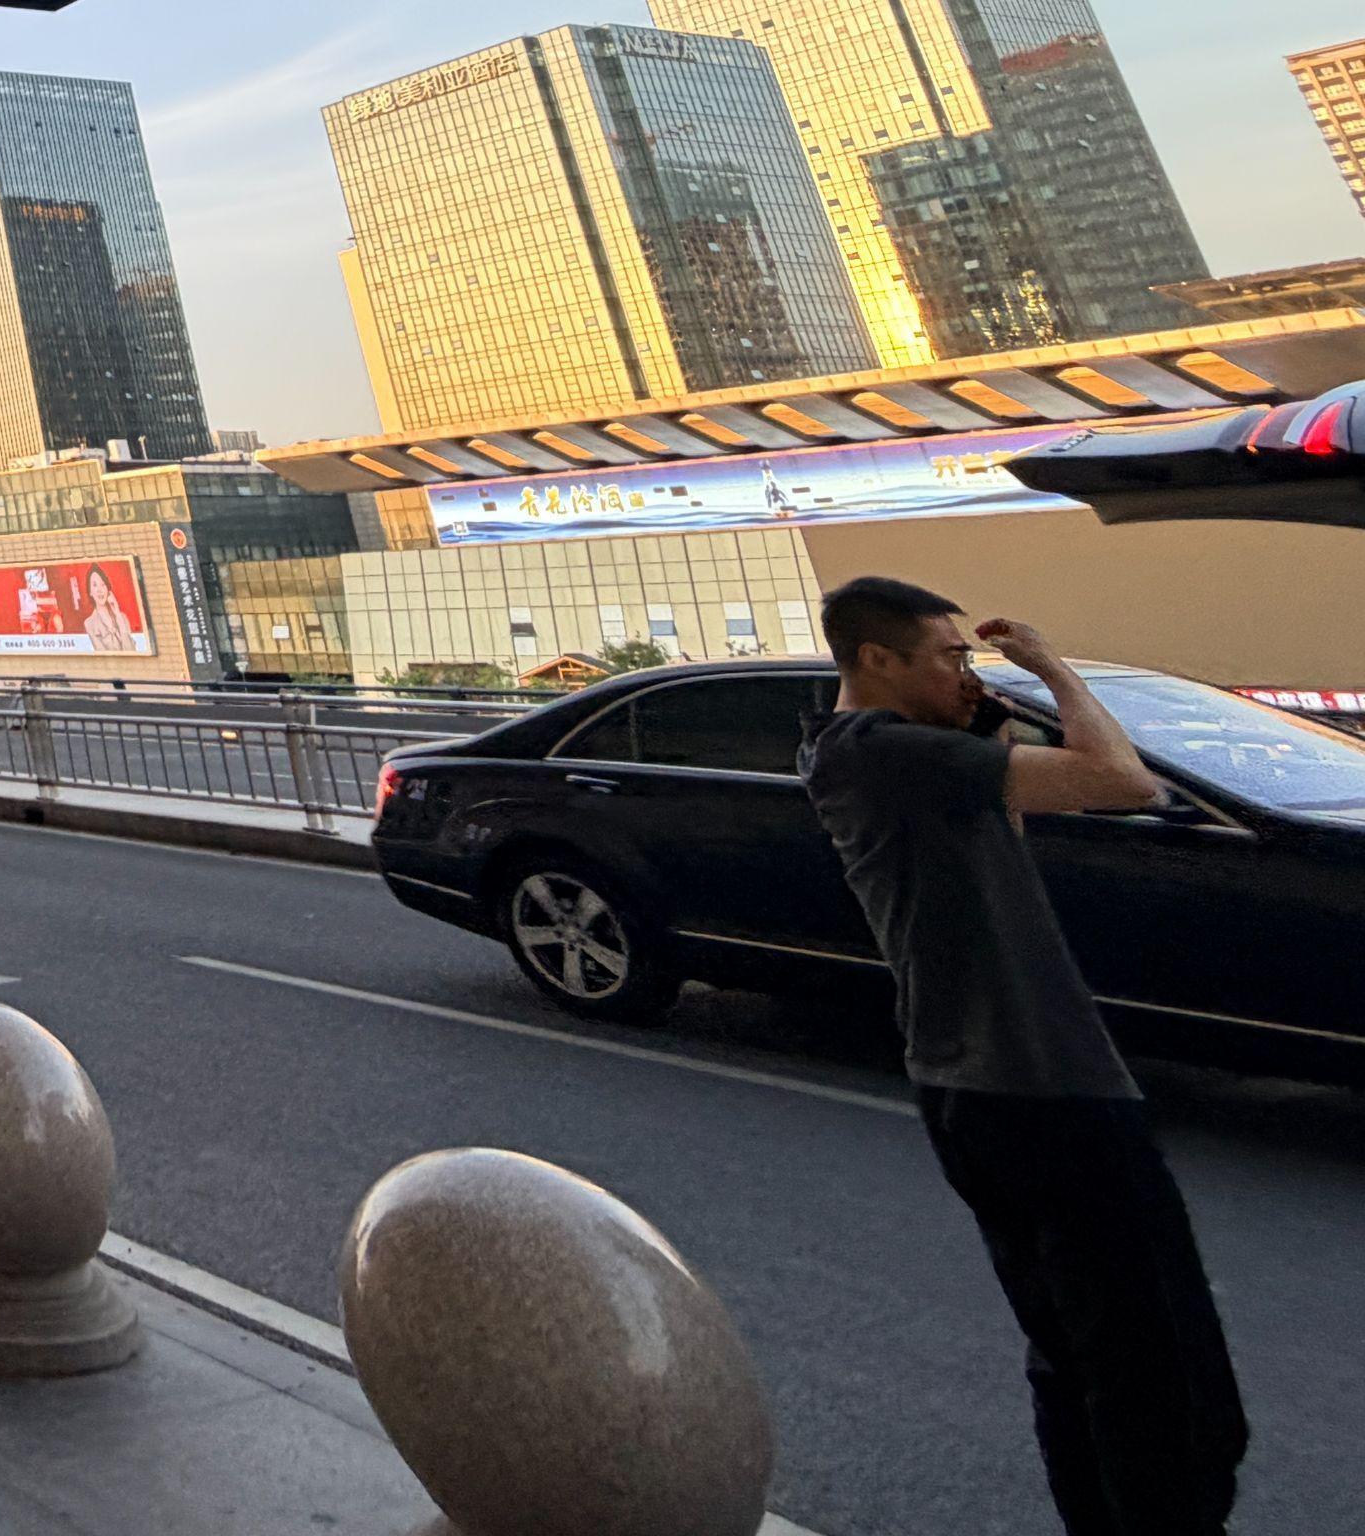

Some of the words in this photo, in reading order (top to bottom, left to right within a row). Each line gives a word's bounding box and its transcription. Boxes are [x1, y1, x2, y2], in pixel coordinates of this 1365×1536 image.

[349, 52, 520, 122] 绿地美利亚酒店
[519, 483, 625, 518] 青花汾酒
